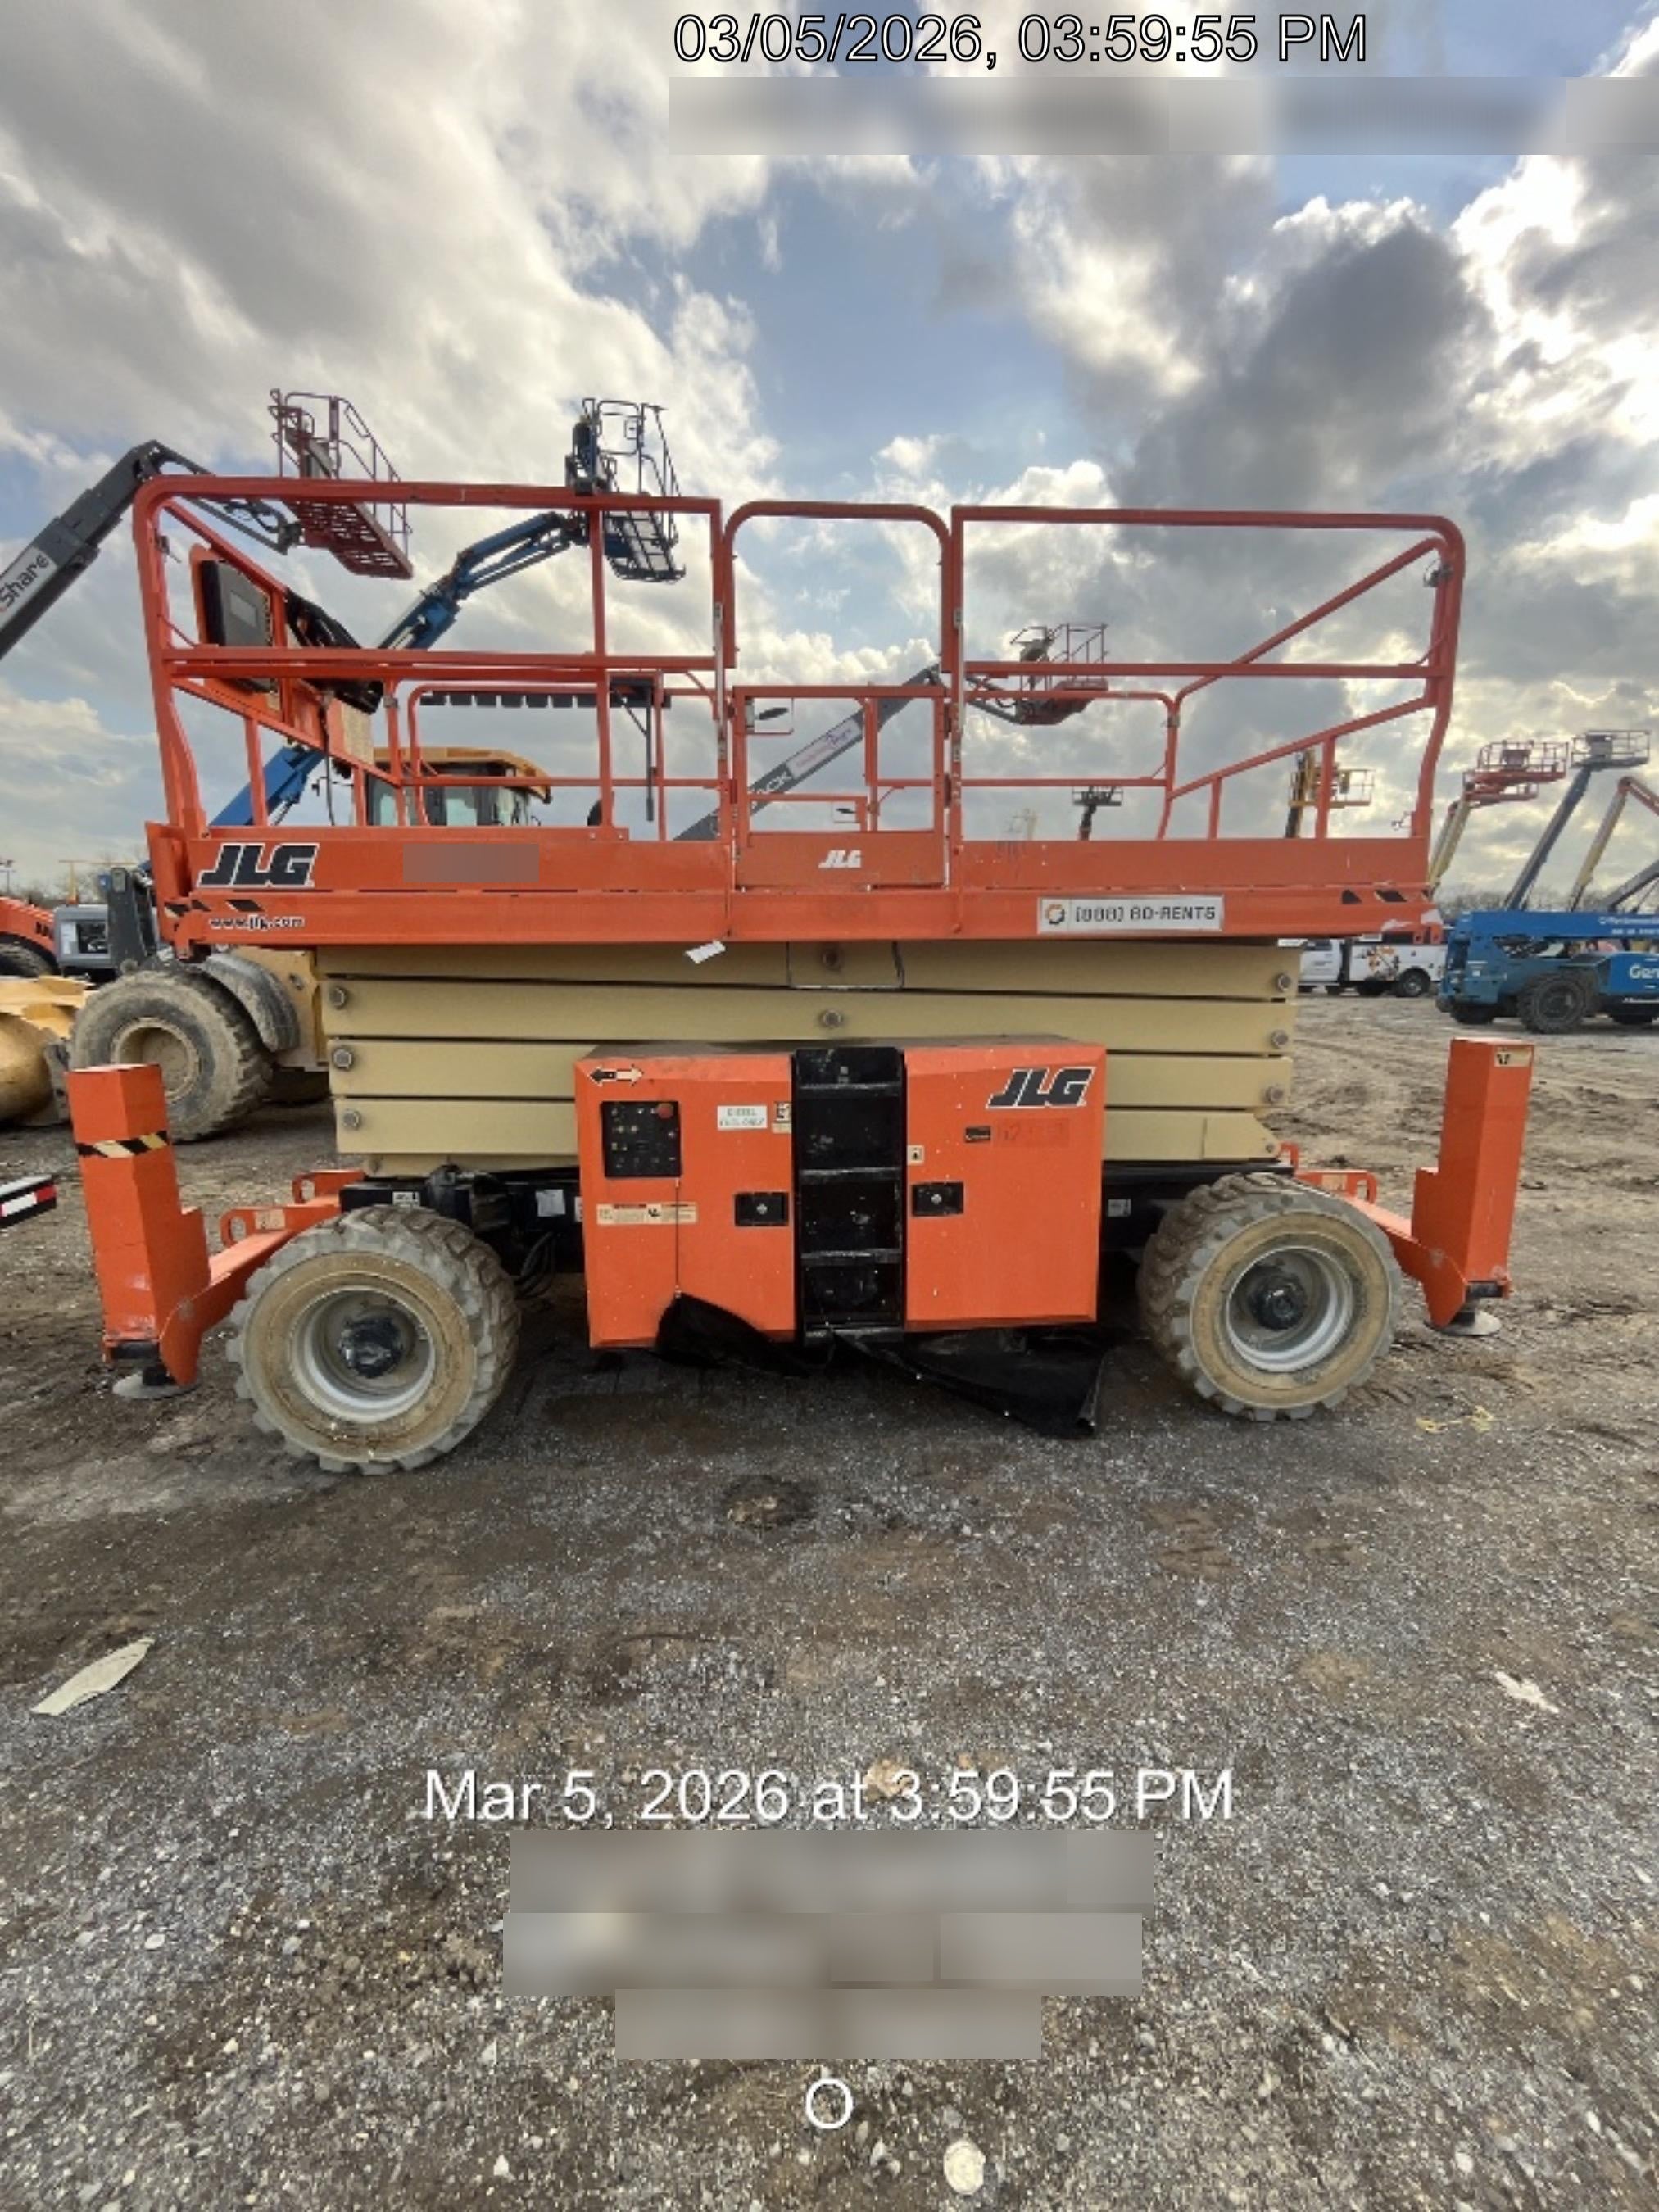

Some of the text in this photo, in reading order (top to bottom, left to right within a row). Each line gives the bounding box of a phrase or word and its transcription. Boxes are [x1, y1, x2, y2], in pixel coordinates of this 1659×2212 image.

[197, 842, 320, 887] JLG
[818, 850, 861, 868] JLG
[986, 1067, 1096, 1109] JLG
